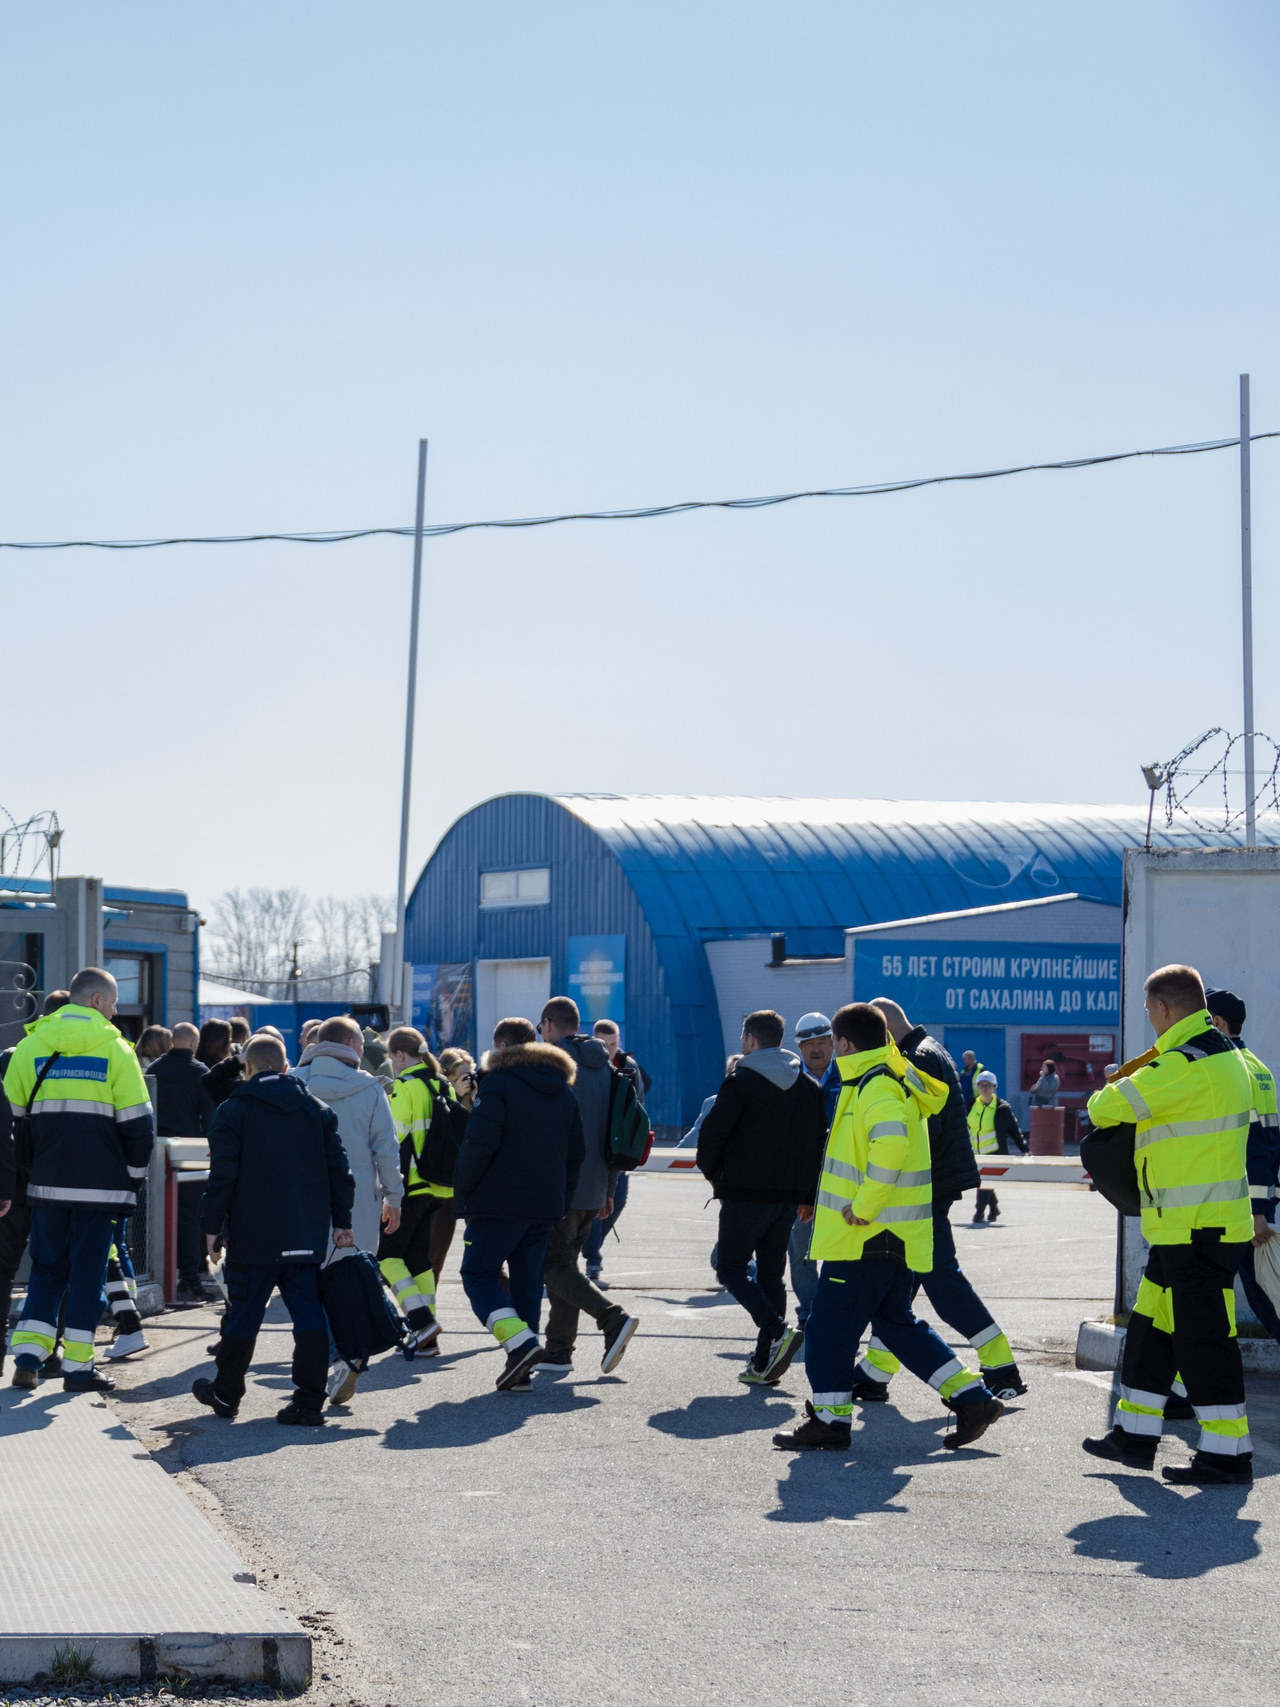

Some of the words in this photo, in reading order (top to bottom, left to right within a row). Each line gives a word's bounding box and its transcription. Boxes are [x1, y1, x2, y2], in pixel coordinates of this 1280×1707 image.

[882, 955, 903, 977] 55
[907, 956, 938, 978] ЛЕТ
[942, 957, 1006, 978] СТРОИМ
[1010, 955, 1118, 979] КРУПНЕЙШИЕ
[946, 988, 965, 1010] ОТ
[970, 988, 1055, 1010] САХАЛИНА
[1059, 990, 1082, 1013] ДО
[1086, 990, 1118, 1011] КАЛ
